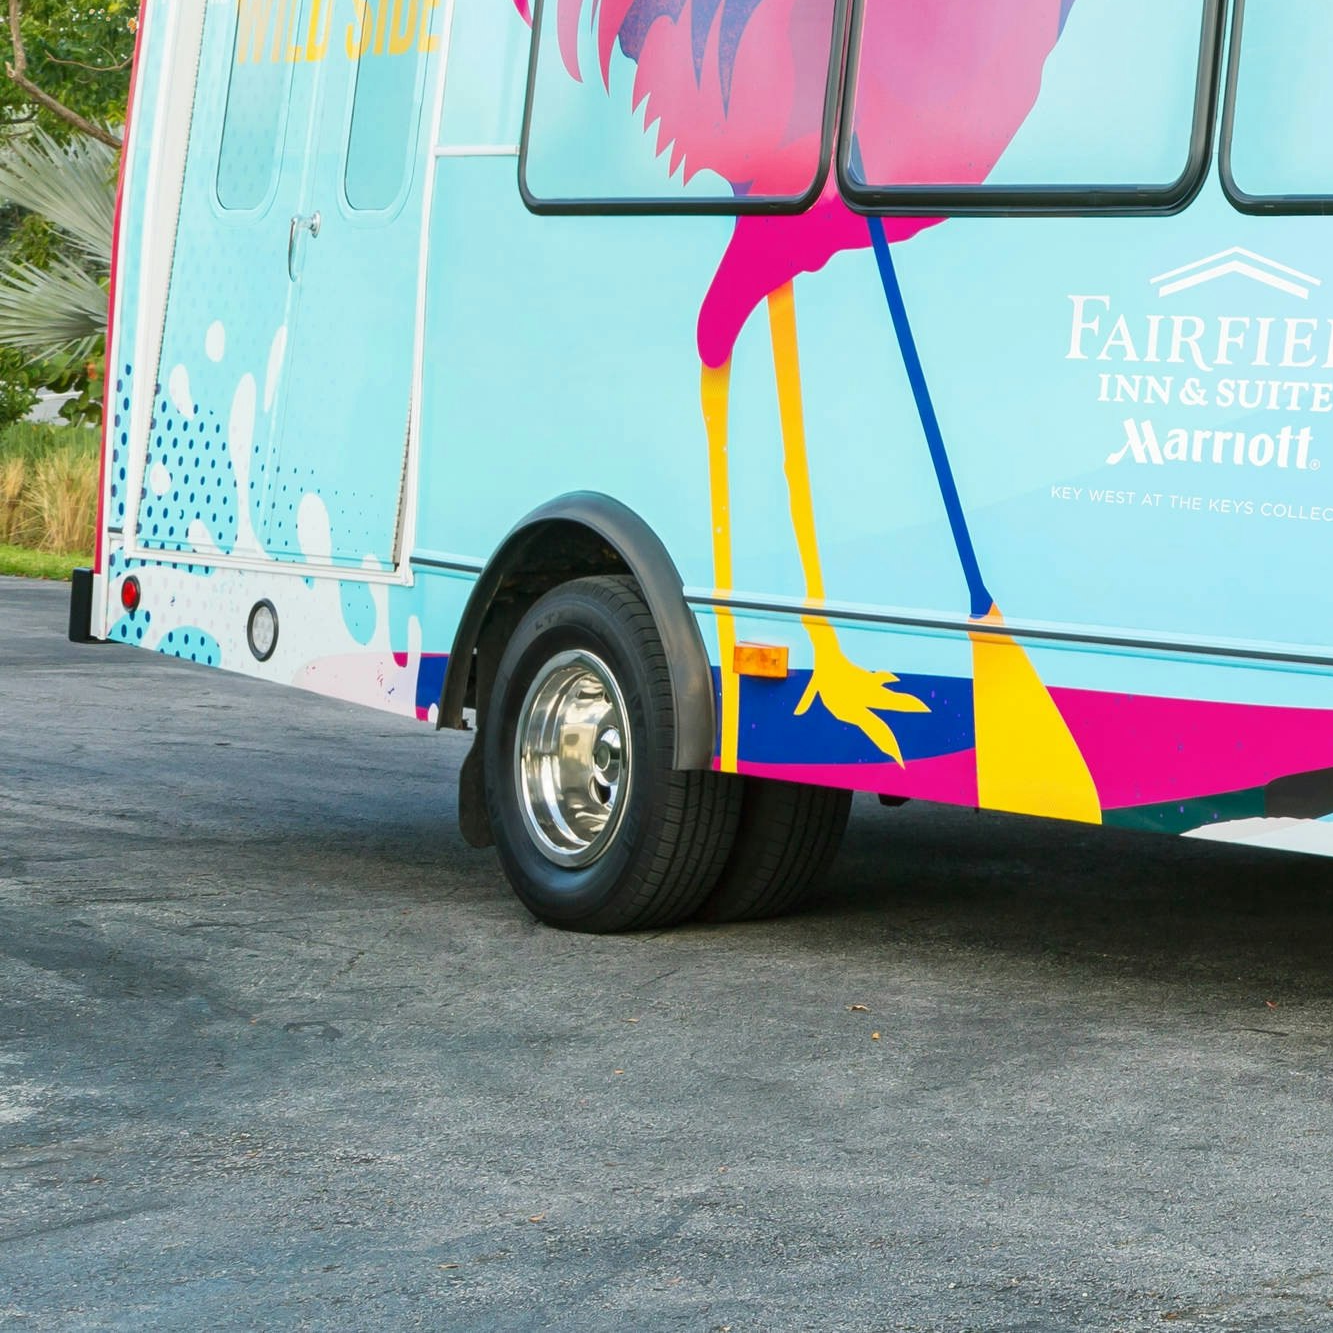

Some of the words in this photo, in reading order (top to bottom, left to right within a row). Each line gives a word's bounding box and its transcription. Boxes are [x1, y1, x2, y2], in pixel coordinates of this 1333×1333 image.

[1097, 374, 1174, 405] INN
[1179, 377, 1208, 406] &
[1051, 486, 1083, 501] KEY
[1088, 489, 1136, 506] WEST
[1141, 493, 1165, 506] AT
[1170, 495, 1202, 511] THE
[1209, 499, 1254, 516] KEYS
